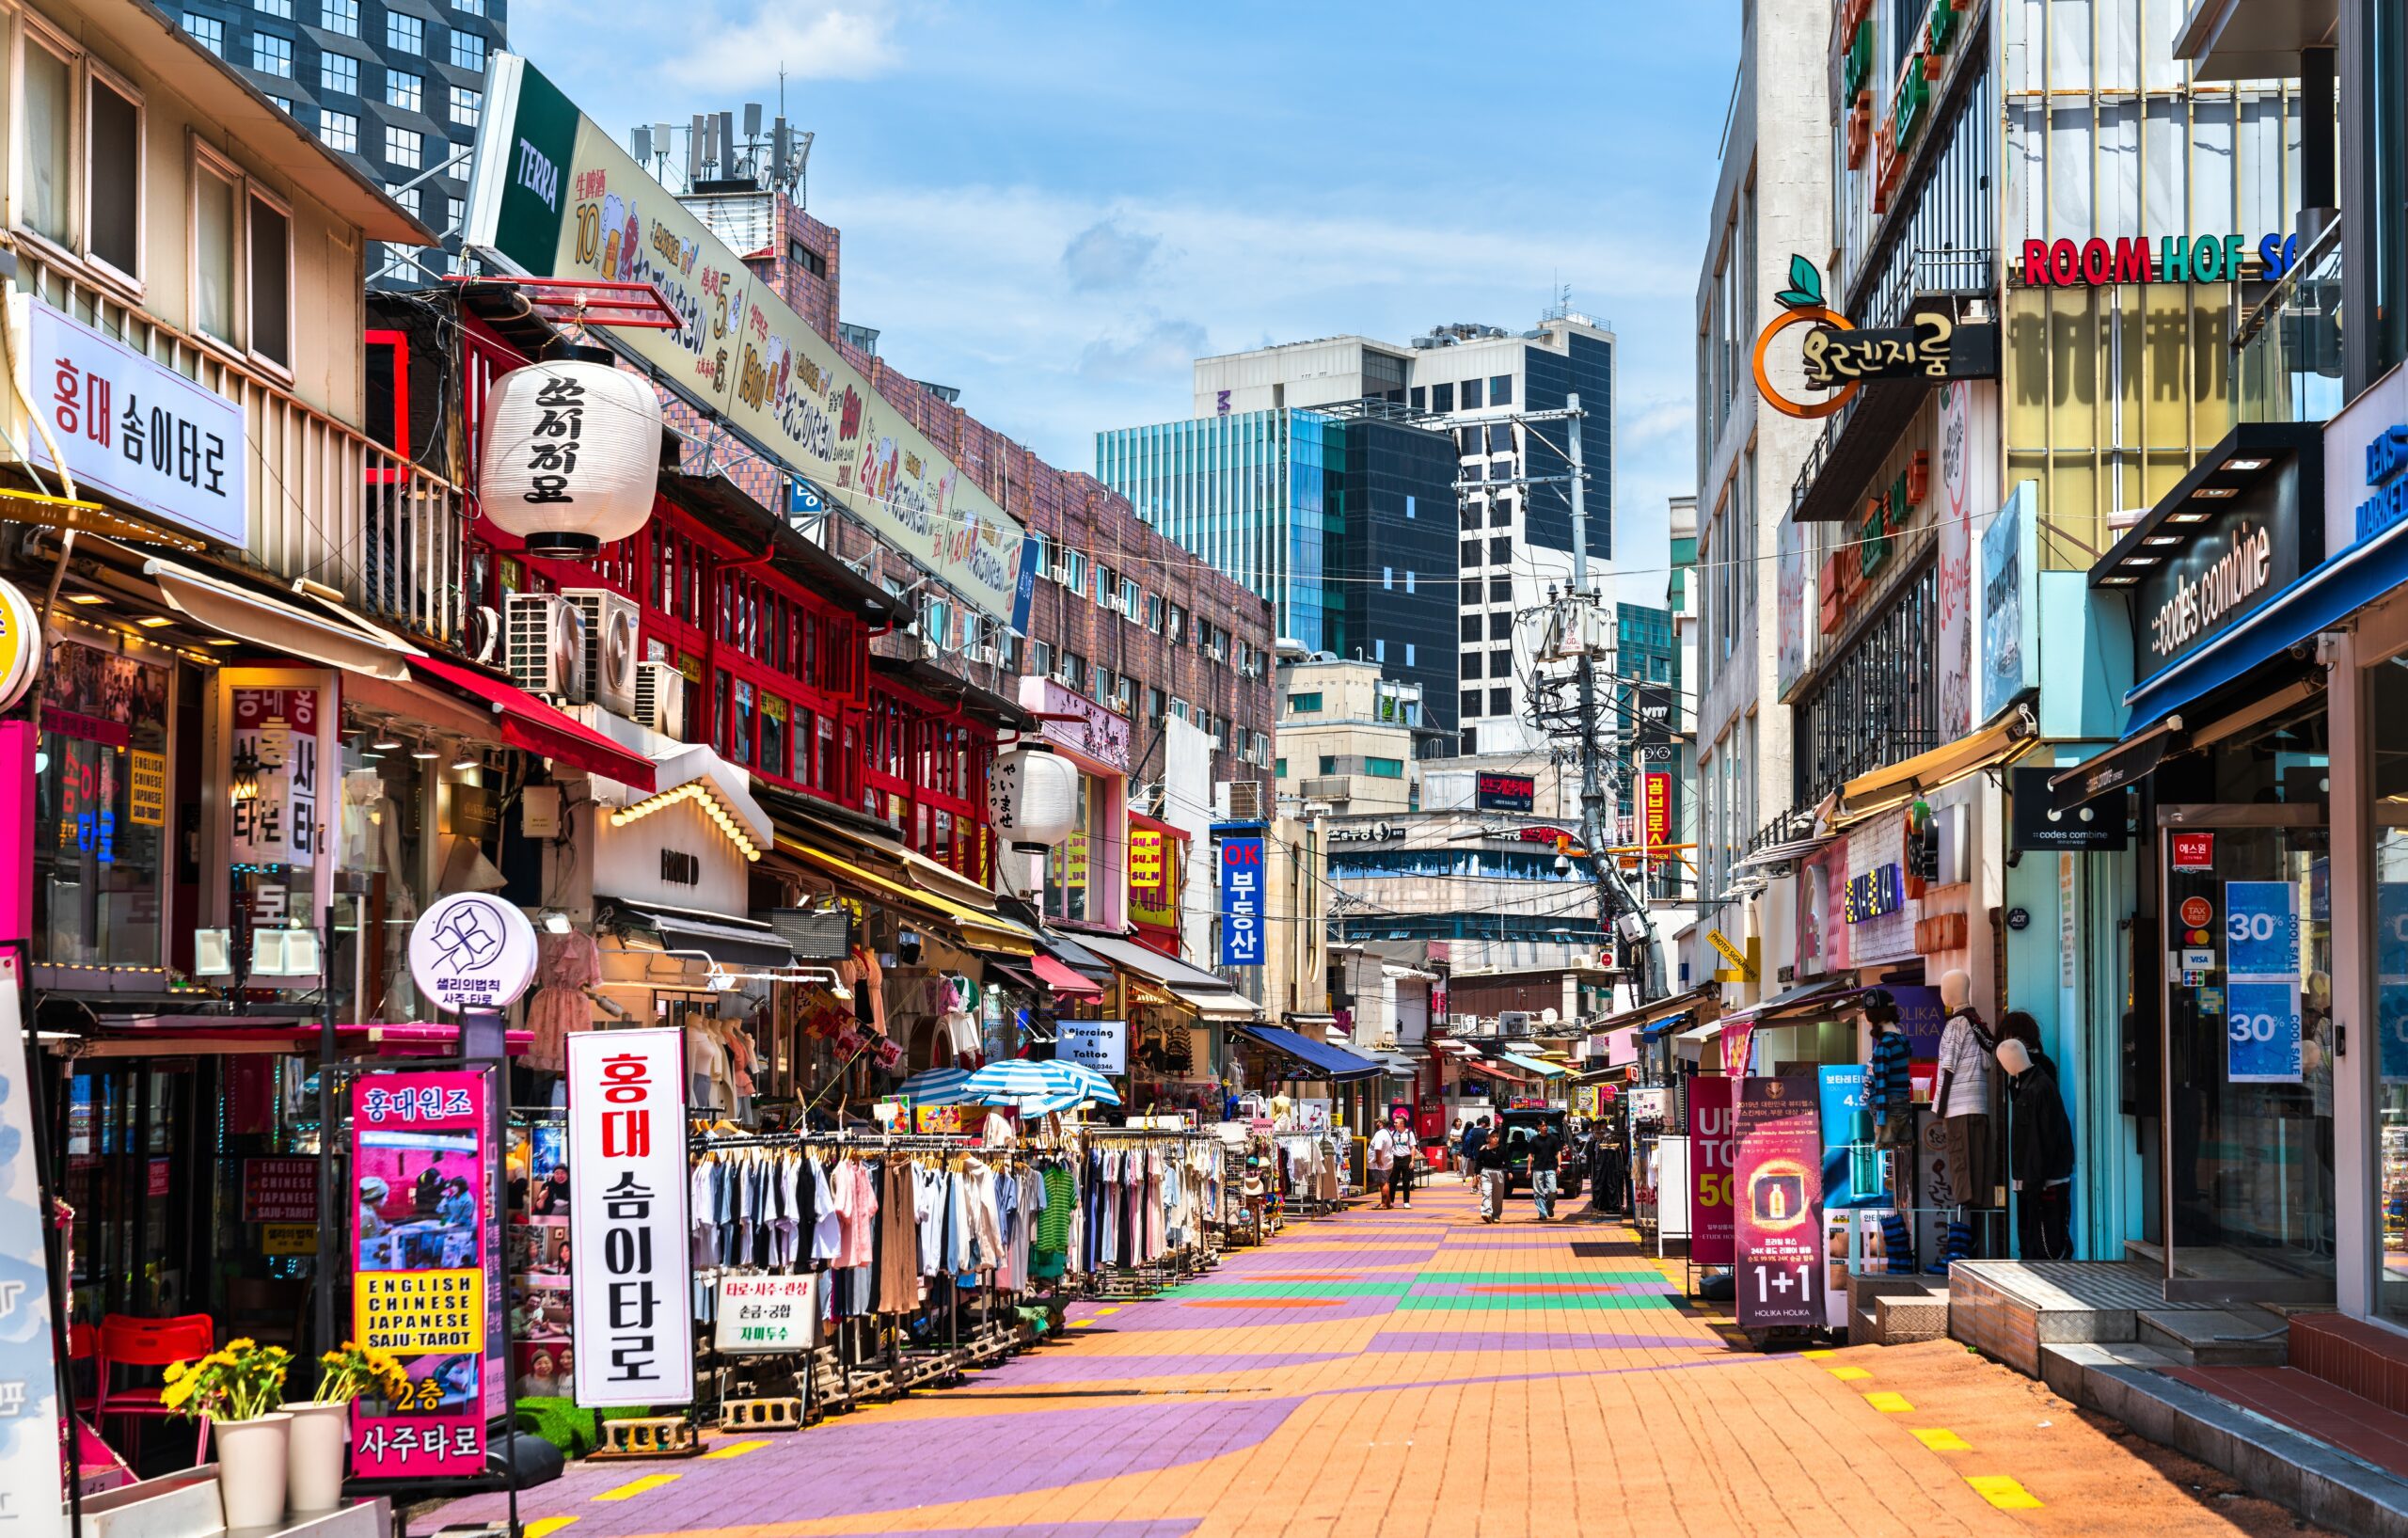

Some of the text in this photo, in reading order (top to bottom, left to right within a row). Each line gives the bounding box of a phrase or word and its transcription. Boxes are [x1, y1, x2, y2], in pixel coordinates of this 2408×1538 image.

[517, 137, 559, 214] TERRA
[575, 169, 606, 201] 生啤酒
[2023, 235, 2153, 285] ROOM
[2162, 234, 2245, 283] HOF
[751, 303, 768, 343] 생맥주
[1802, 312, 1952, 382] 오렌지룸
[738, 342, 766, 412] 1900
[54, 358, 227, 499] 홍대 솜이타로
[523, 376, 585, 503] 쏘시지요
[2366, 425, 2408, 486] LENS
[2159, 521, 2271, 657] codes combine
[135, 756, 163, 772] ENGLISH
[135, 772, 163, 788] CHINESE
[134, 788, 162, 804] JAPANESE
[2039, 831, 2108, 839] codes combine
[2178, 844, 2207, 854] 에스원
[1224, 845, 1259, 865] OK
[1228, 871, 1258, 959] 부동산
[1711, 933, 1758, 979] PHOTO SIGNATURE
[2289, 913, 2299, 974] COOL SALE
[436, 976, 500, 993] 샐리의법칙
[1897, 1008, 1941, 1021] OLIKA
[1897, 1024, 1941, 1037] OLIKA
[1069, 1027, 1114, 1039] Piercing
[2290, 1015, 2301, 1074] COOL SALE
[362, 1087, 473, 1122] 홍대원조
[261, 1162, 313, 1173] ENGLISH
[261, 1178, 313, 1189] CHINESE
[259, 1192, 315, 1204] JAPANESE
[599, 1053, 661, 1382] 홍대 솜이타로
[369, 1277, 470, 1293] ENGLISH
[1753, 1264, 1810, 1303] 1+1
[369, 1295, 469, 1311] CHINESE
[369, 1313, 469, 1329] JAPANESE
[740, 1326, 789, 1341] 자미두수
[396, 1379, 446, 1411] 2층
[359, 1424, 481, 1464] 사주타로
